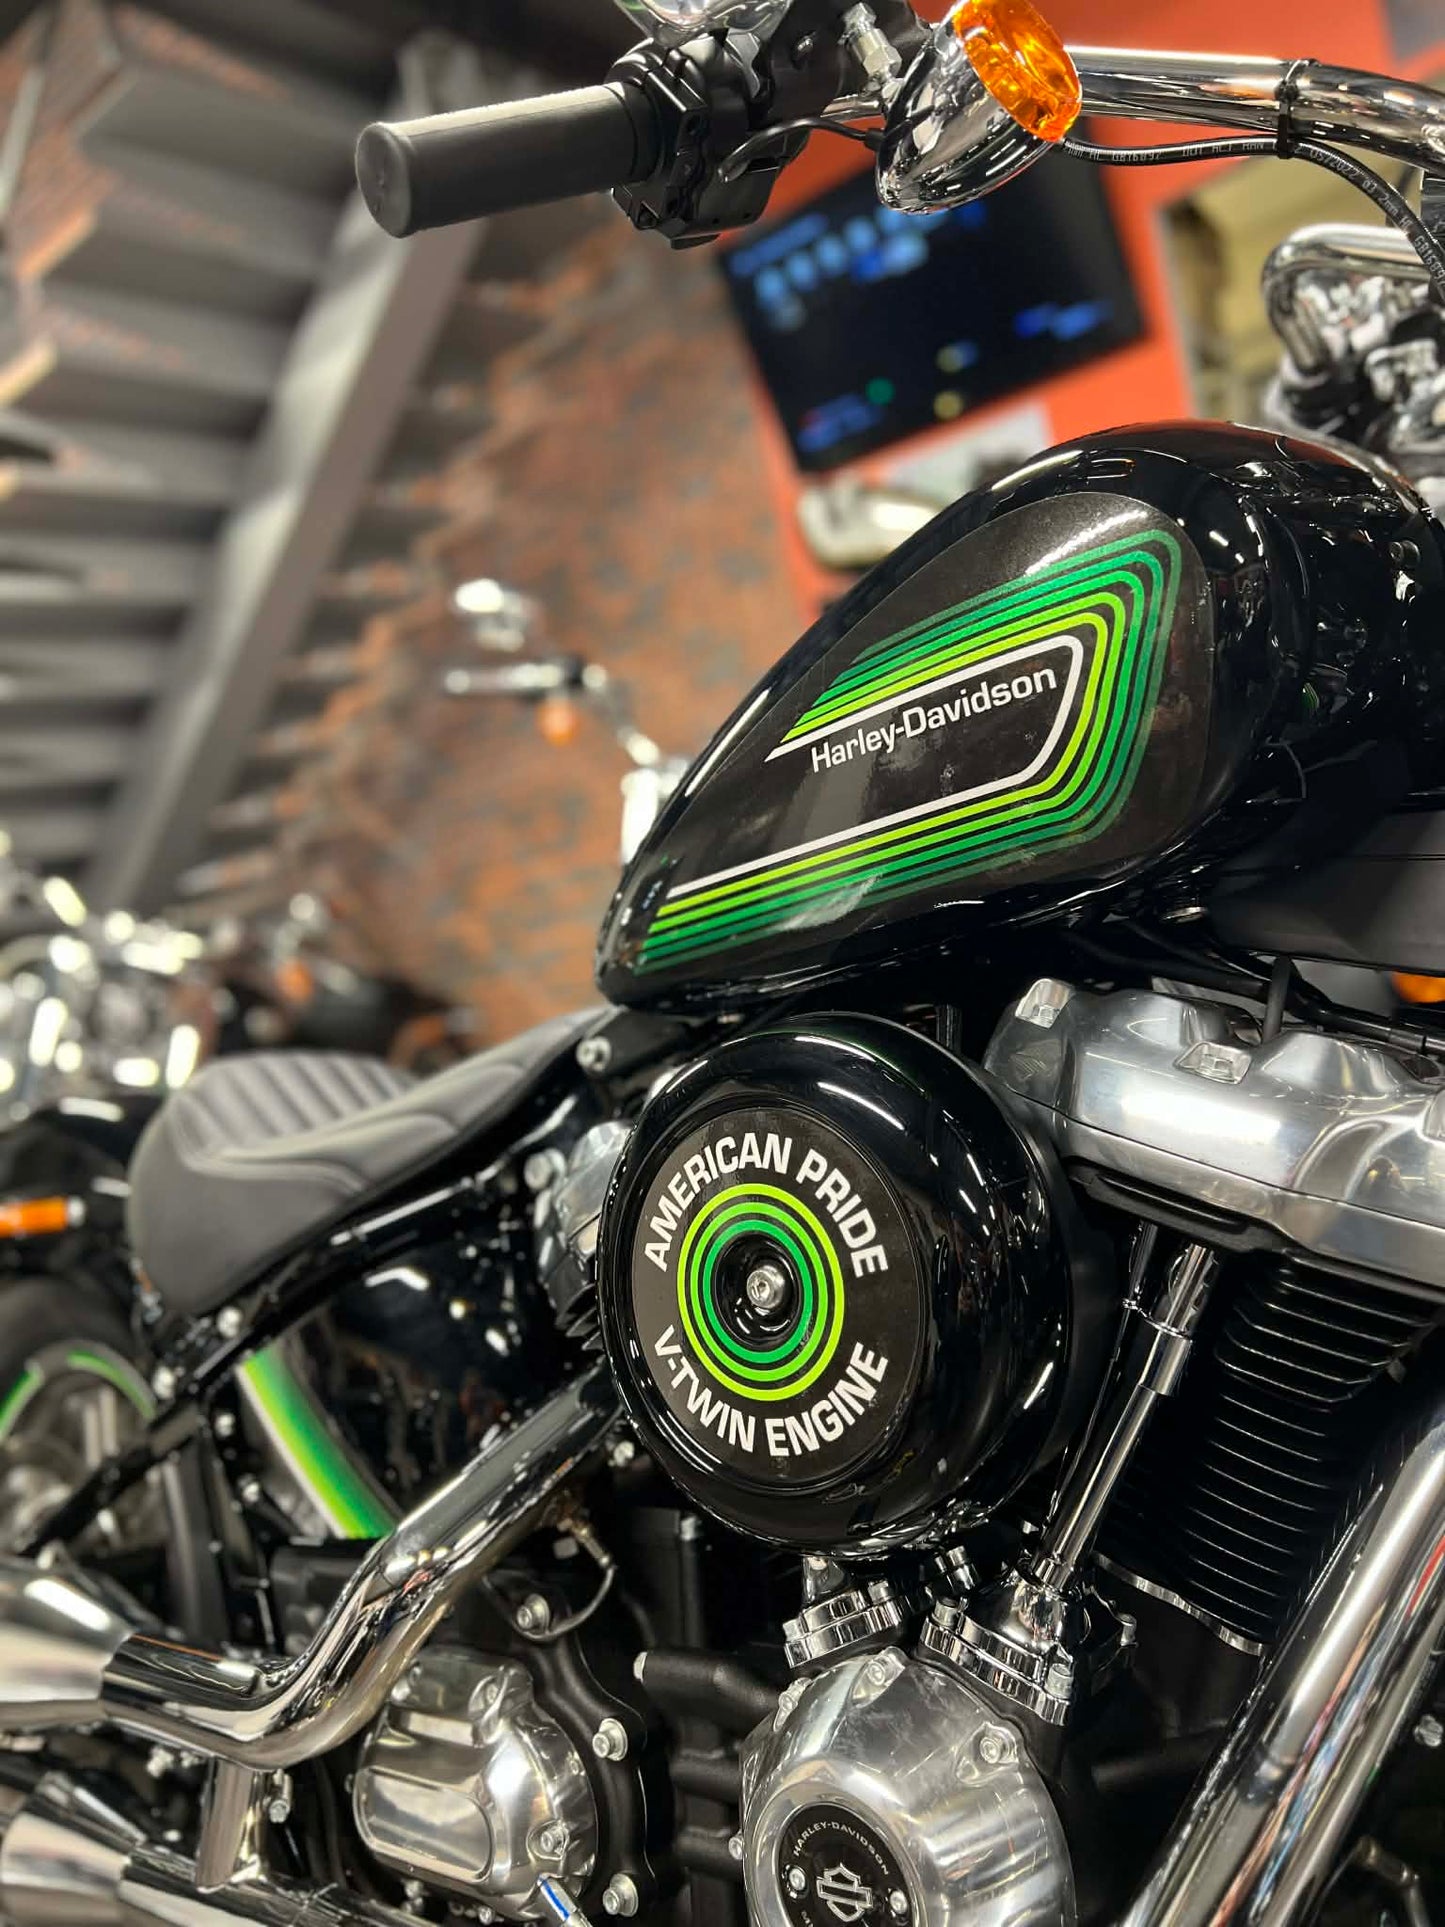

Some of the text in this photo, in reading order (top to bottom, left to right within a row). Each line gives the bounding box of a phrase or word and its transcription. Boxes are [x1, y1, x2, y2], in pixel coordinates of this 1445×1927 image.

[811, 668, 1057, 773] Harley-Davidson
[644, 1132, 889, 1278] AMERICAN PRIDE
[654, 1325, 889, 1457] V-TWIN ENGINE
[793, 1821, 889, 1875] HARLEY-DAVIDSON
